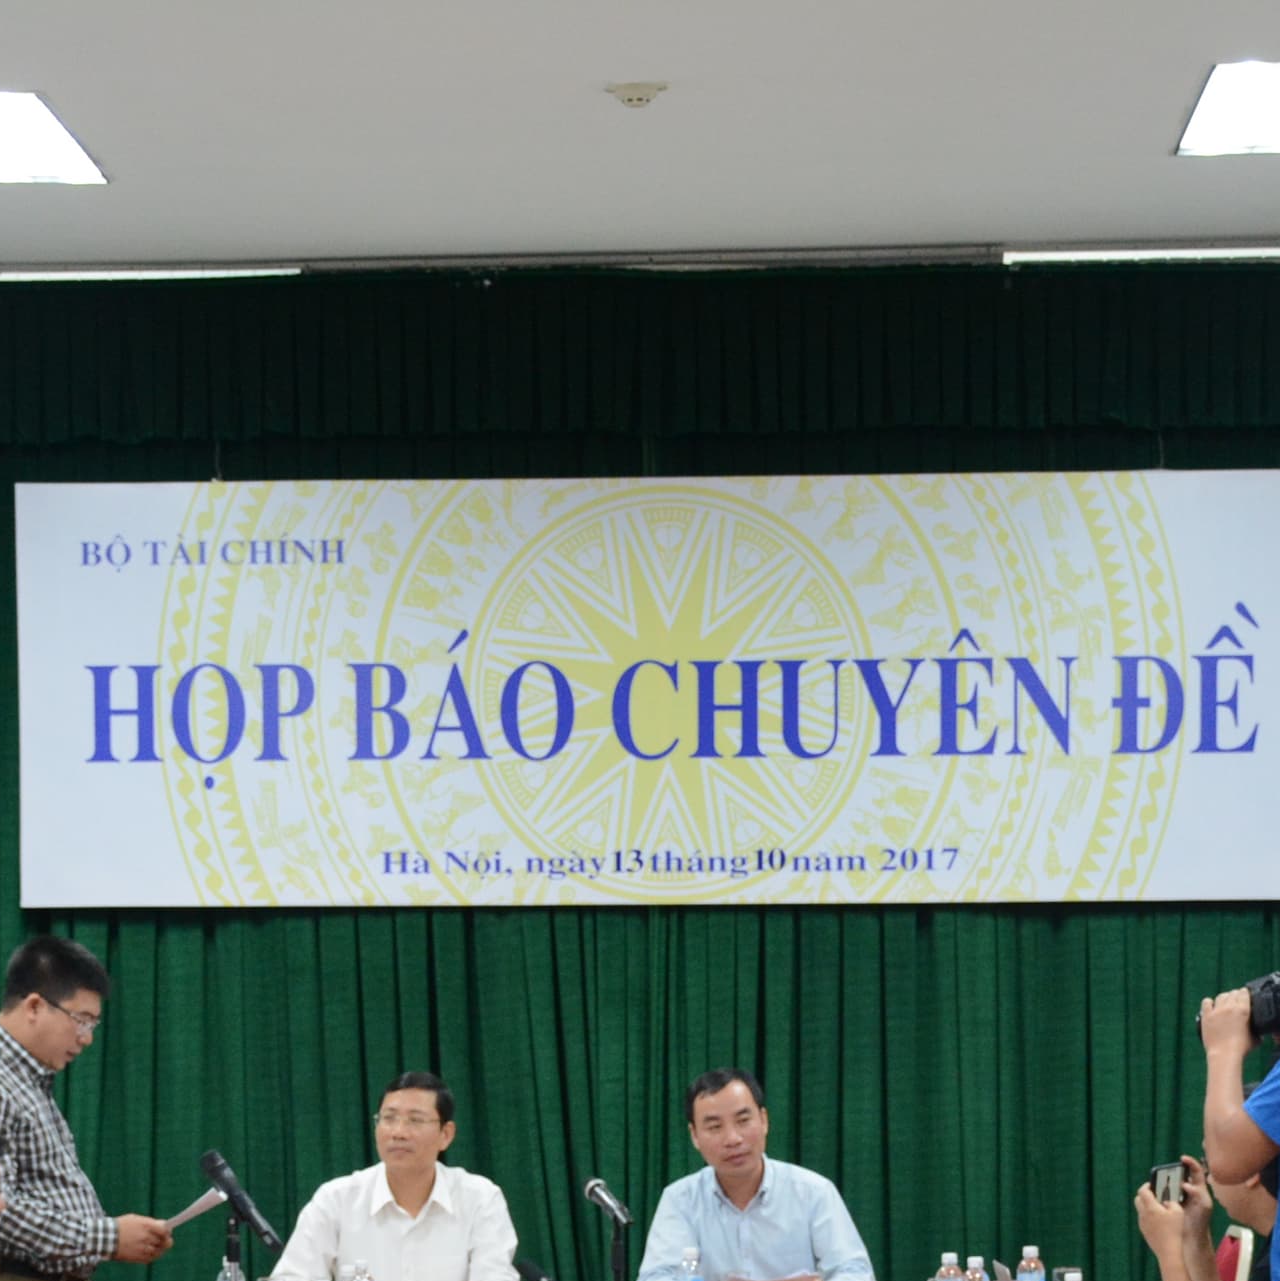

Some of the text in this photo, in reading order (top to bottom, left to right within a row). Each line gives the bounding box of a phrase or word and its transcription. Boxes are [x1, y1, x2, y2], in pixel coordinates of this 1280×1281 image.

[81, 532, 345, 573] BỘ TÀI CHÍNH
[84, 601, 1261, 789] HỌP BÁO CHUYÊN ĐỀ
[383, 850, 430, 875] Hà
[444, 850, 513, 879] Nội,
[880, 847, 960, 872] 2017
